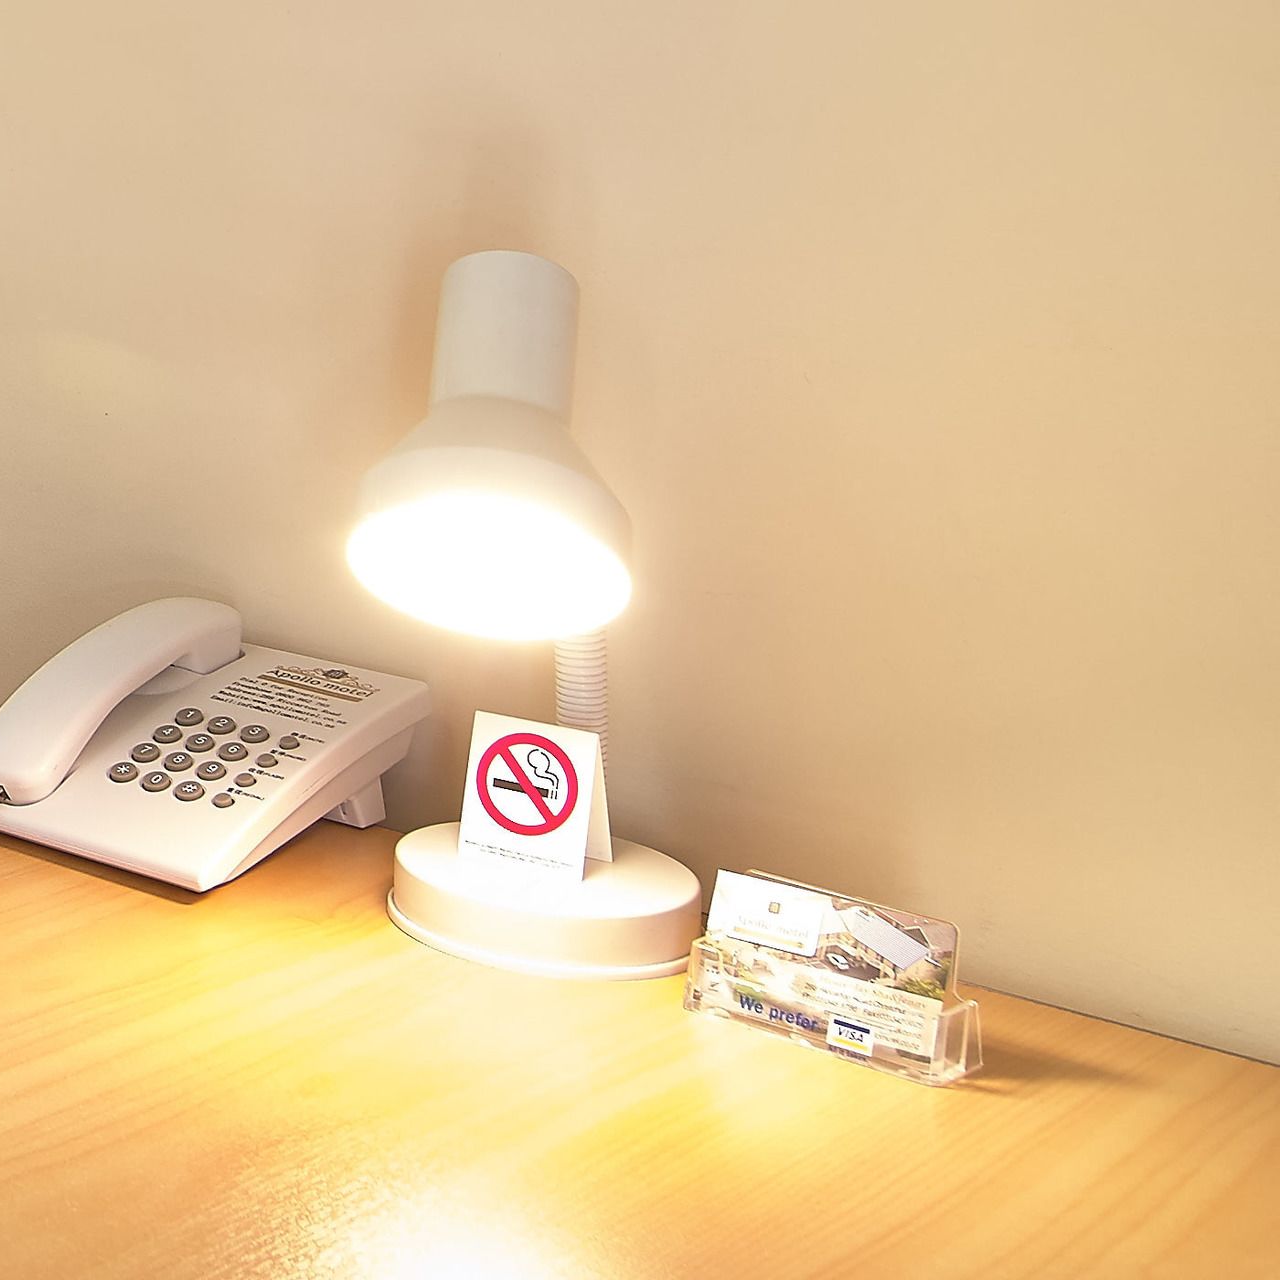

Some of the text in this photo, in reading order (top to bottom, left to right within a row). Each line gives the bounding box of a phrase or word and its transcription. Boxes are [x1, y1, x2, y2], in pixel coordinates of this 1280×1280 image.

[266, 669, 374, 698] Apollo motel
[187, 710, 262, 735] 1 2 3
[162, 727, 241, 754] 4 5 6
[140, 745, 219, 773] 7 8 9
[151, 774, 163, 784] 0
[740, 992, 819, 1032] We prefer
[837, 1026, 864, 1043] VISA
